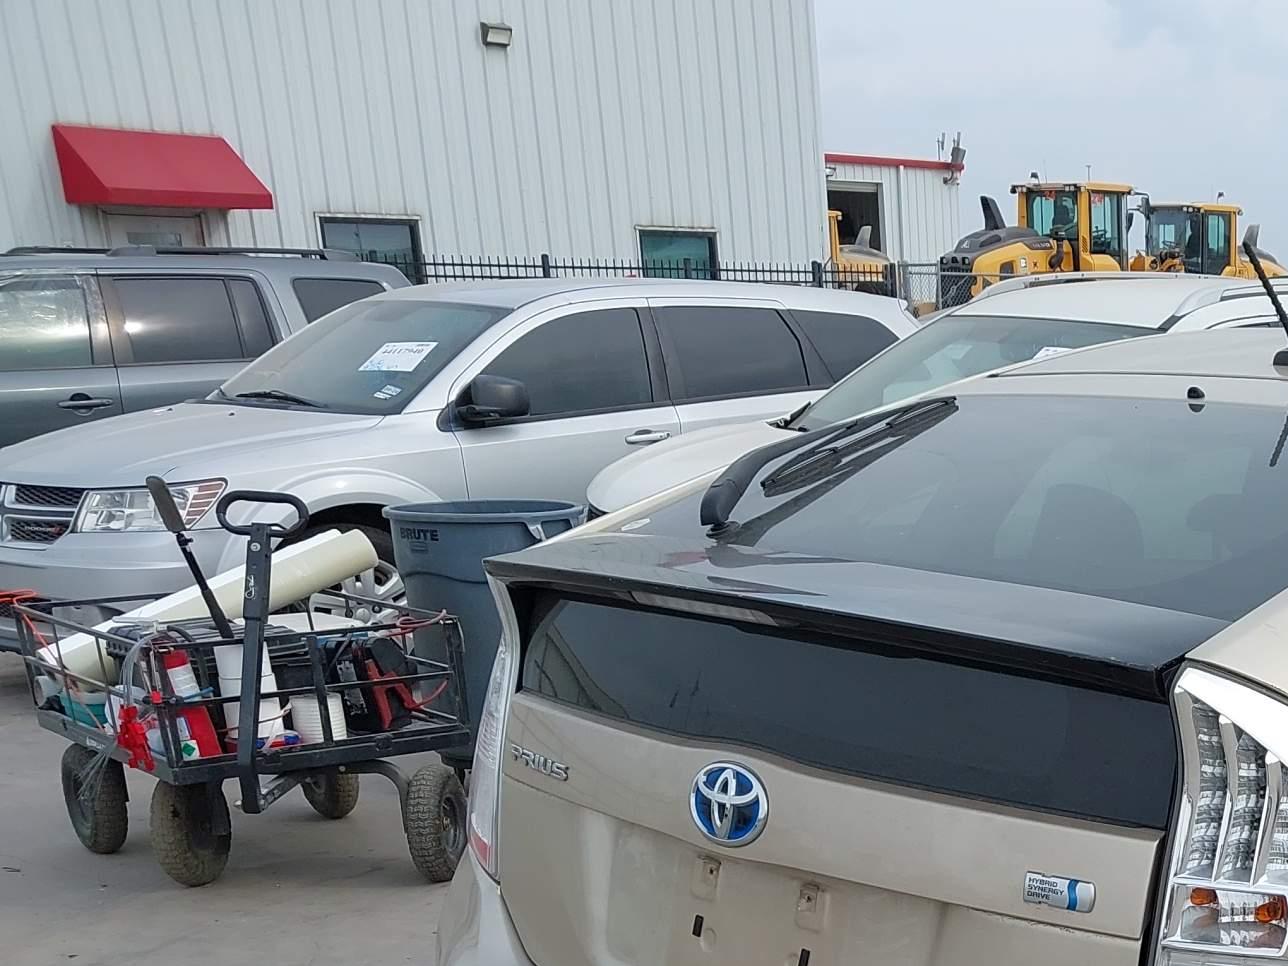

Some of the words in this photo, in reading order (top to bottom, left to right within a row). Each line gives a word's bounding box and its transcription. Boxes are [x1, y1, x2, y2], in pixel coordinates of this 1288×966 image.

[400, 527, 440, 541] BRUTE
[510, 743, 569, 781] PRIUS
[1028, 876, 1058, 887] HYBRID
[1026, 890, 1051, 900] DRIVE
[1027, 884, 1065, 896] SYNERGY
